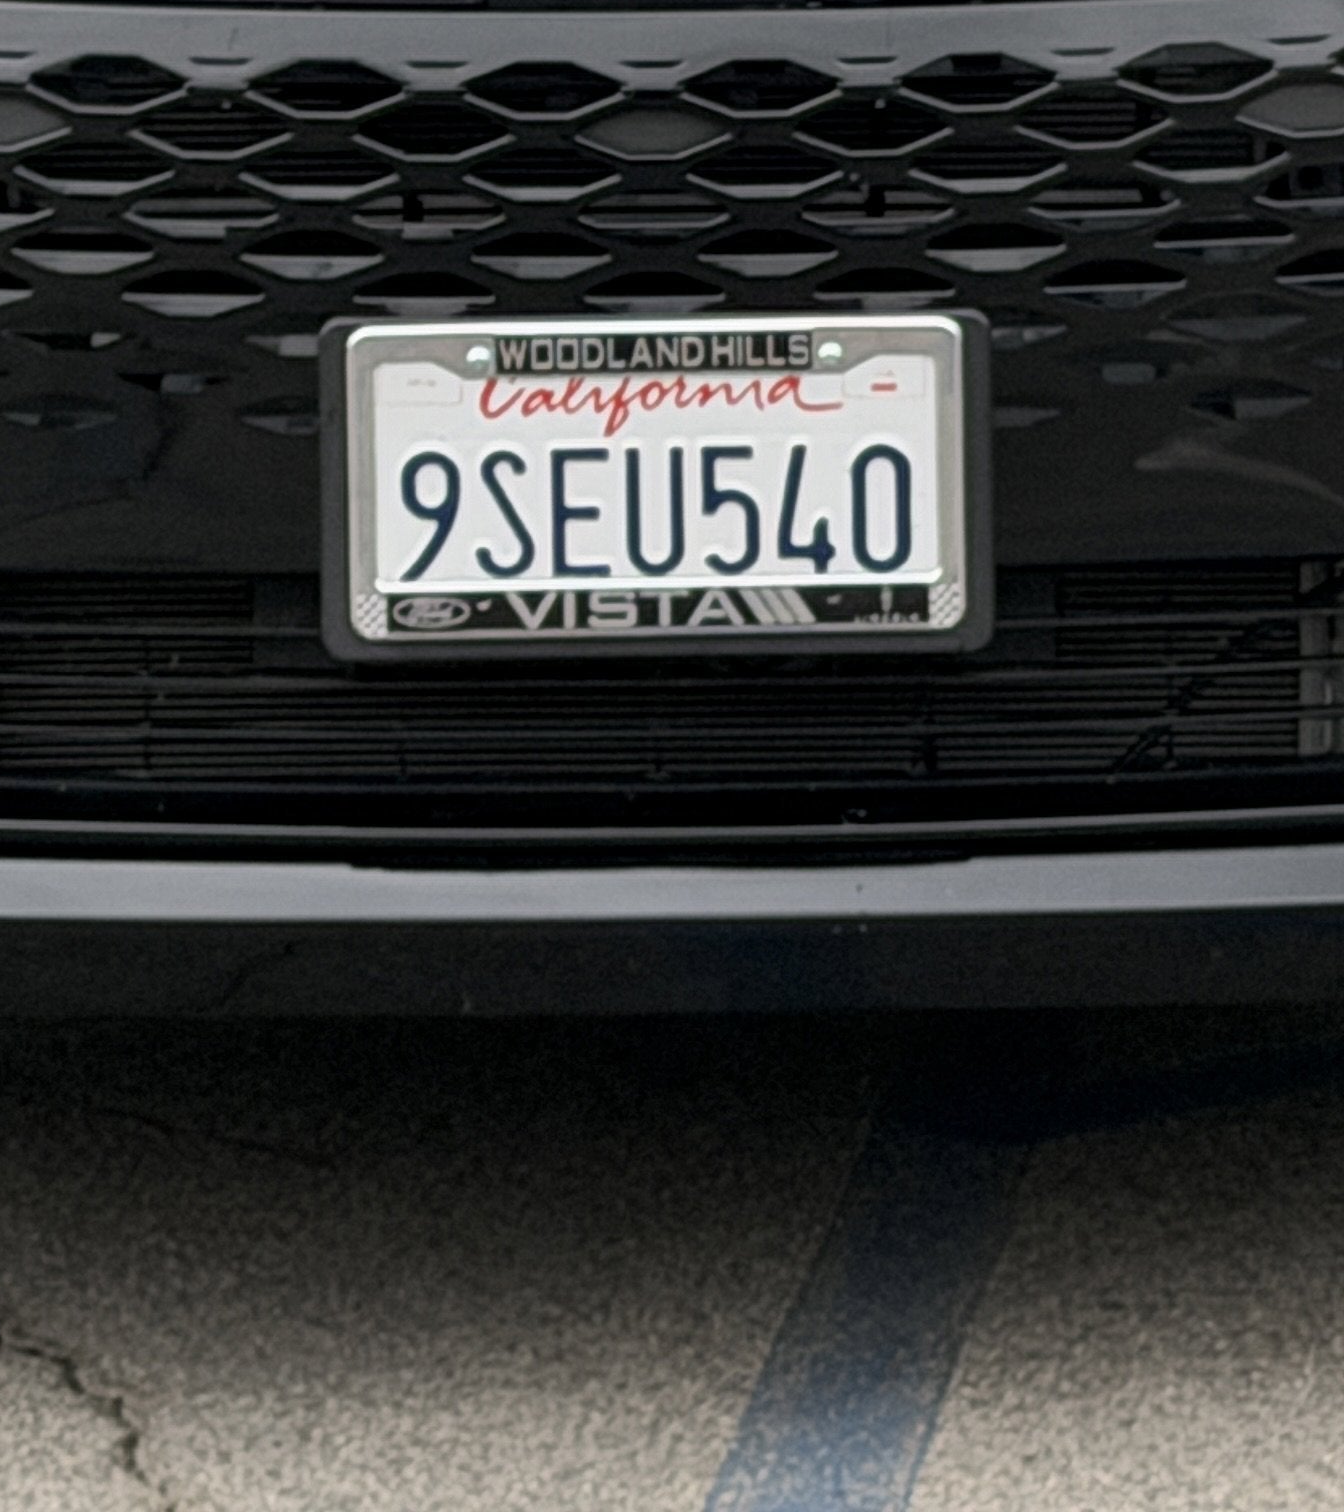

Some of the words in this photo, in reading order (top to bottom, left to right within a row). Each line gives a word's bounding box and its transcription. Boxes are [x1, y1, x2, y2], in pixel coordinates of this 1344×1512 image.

[498, 336, 703, 371] WOODLAND
[710, 333, 810, 368] HILLS
[478, 374, 844, 437] California
[399, 443, 913, 583] 9SEU540
[503, 589, 746, 630] VISTA
